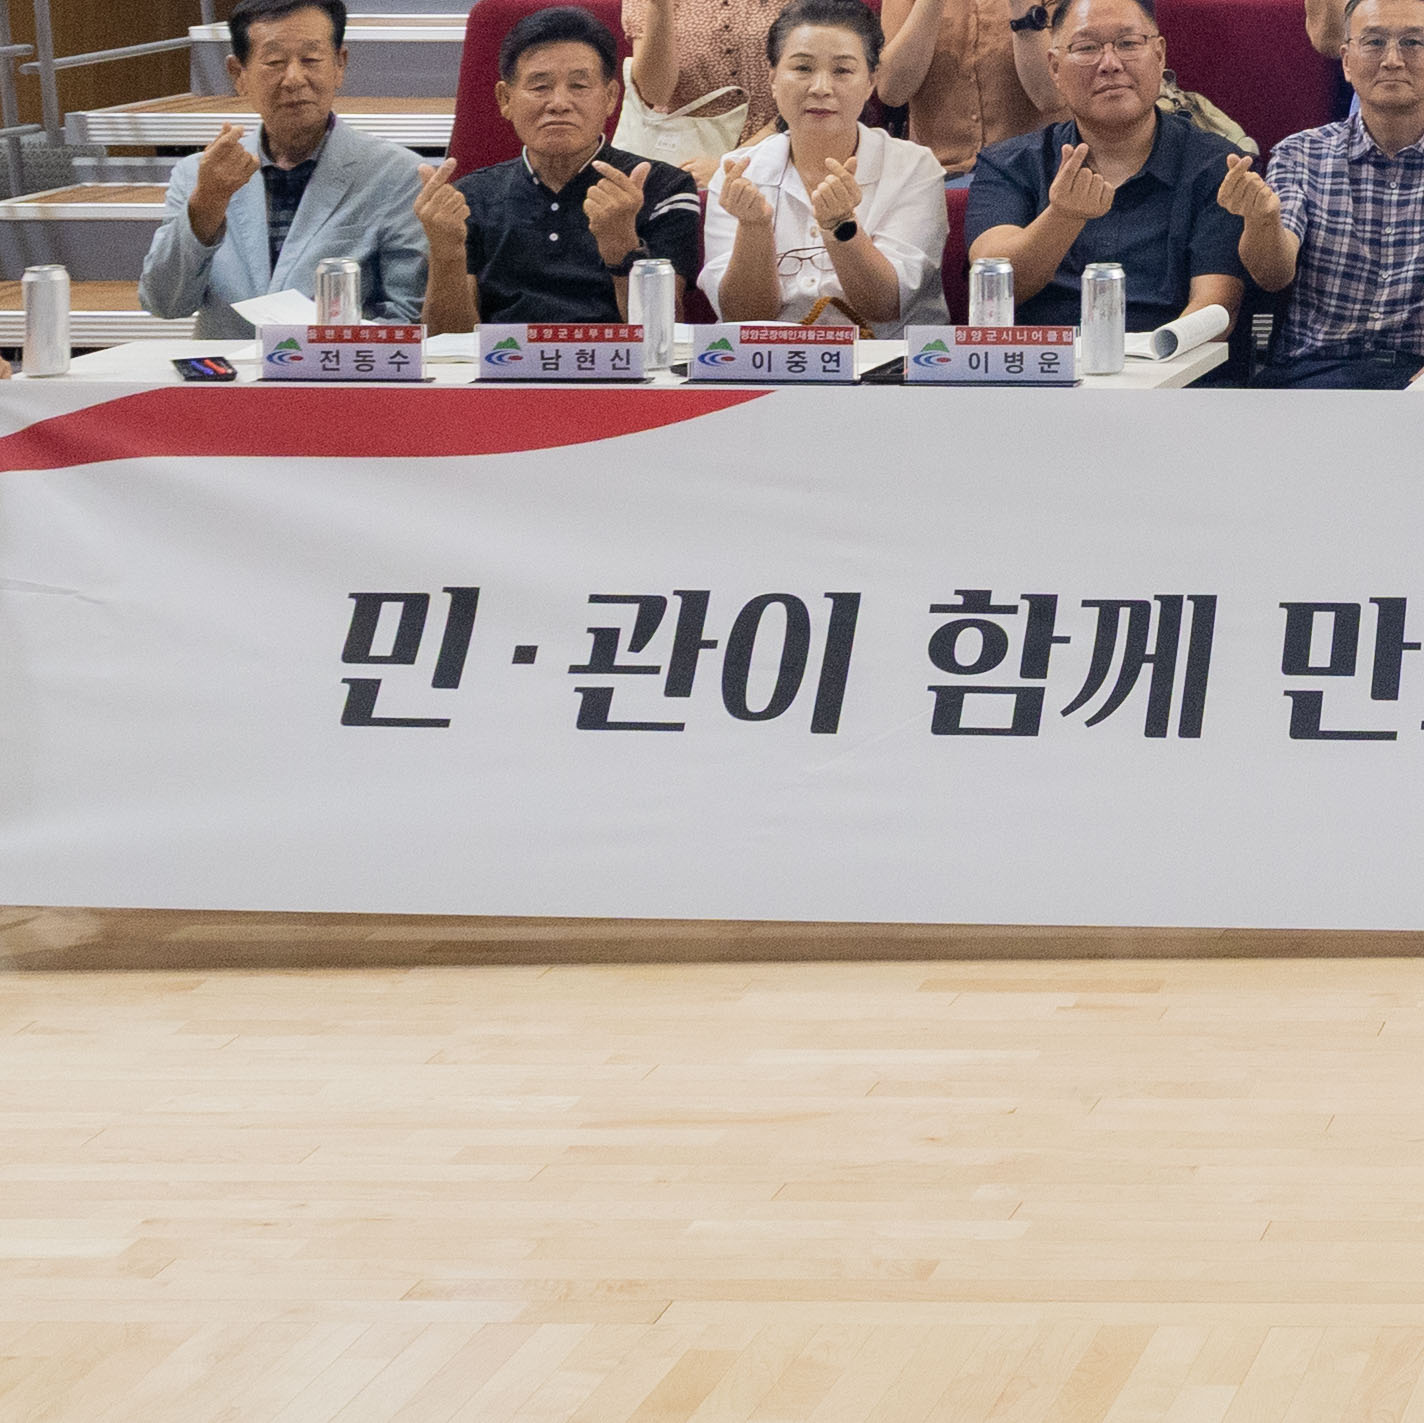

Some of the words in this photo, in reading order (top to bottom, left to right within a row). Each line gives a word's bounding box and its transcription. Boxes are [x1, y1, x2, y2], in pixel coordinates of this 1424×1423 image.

[956, 330, 1073, 343] 청양군시니어클럽
[320, 349, 410, 372] 전동수
[540, 348, 632, 371] 남현신
[752, 350, 841, 374] 이중연
[968, 351, 1060, 375] 이병운
[928, 590, 1218, 740] 함께
